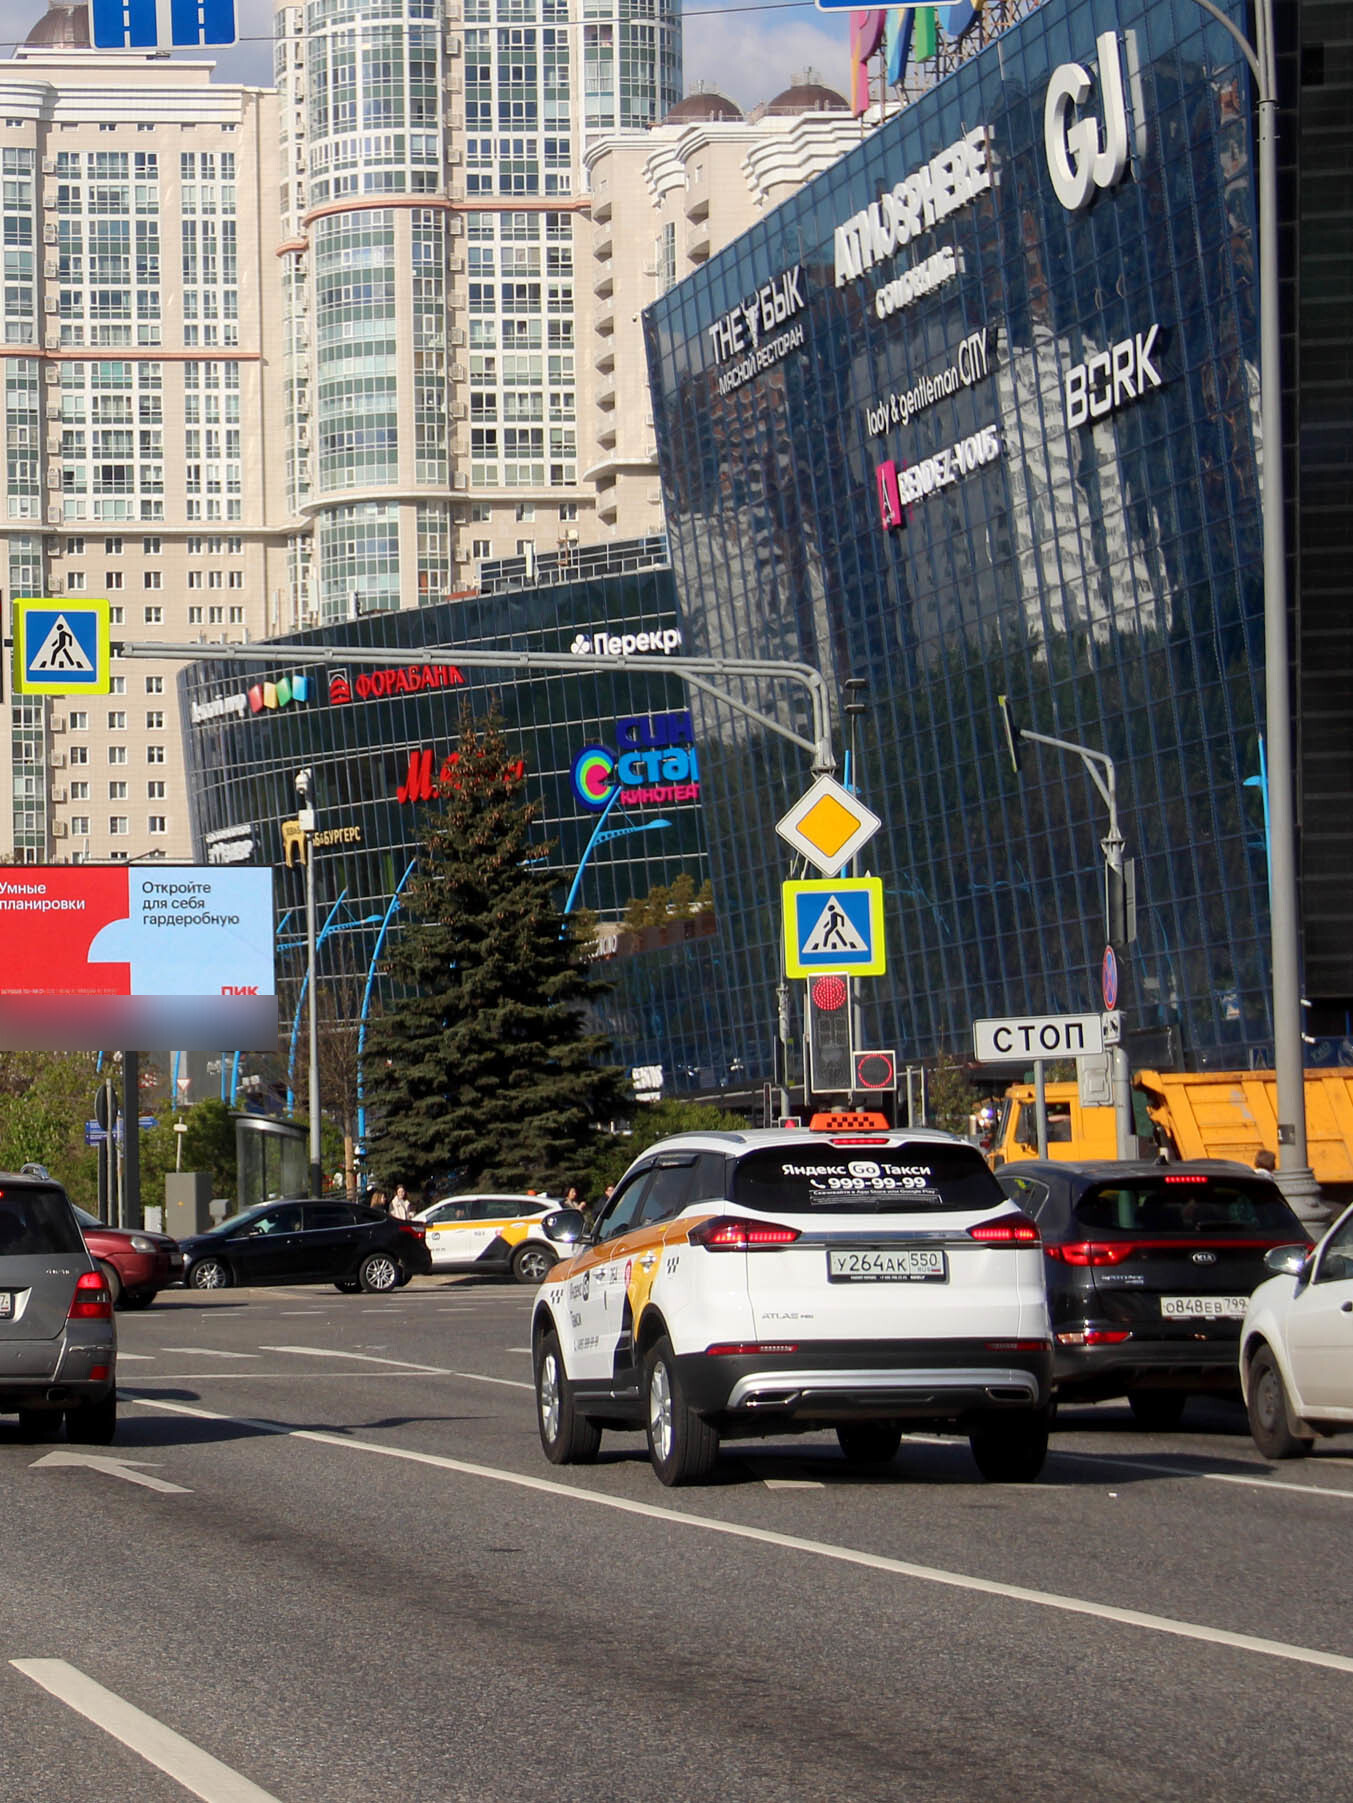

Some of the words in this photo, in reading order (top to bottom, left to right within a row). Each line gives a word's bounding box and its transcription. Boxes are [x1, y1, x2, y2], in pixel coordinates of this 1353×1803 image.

[1044, 30, 1128, 211] GJ
[708, 306, 745, 365] THE
[759, 264, 805, 332] БЫК
[718, 352, 758, 396] МЯСНОЙ
[756, 323, 804, 371] РЕСТОРАН
[866, 408, 889, 436] lady
[890, 394, 900, 424] &
[899, 367, 959, 425] gentleman
[958, 327, 990, 386] CITY
[1066, 323, 1162, 430] BORK
[897, 424, 999, 505] RENDEZ-VOUS
[593, 628, 682, 655] Перекр
[355, 664, 465, 700] ФОРАБАНК
[142, 881, 211, 896] Откройте
[0, 898, 86, 911] планировки
[142, 900, 168, 911] для
[171, 897, 205, 909] себя
[143, 912, 240, 926] гардеробную
[993, 1022, 1084, 1053] СТОП
[782, 1163, 846, 1176] Яндекс
[852, 1163, 877, 1175] Go
[881, 1163, 931, 1175] Такси
[827, 1177, 926, 1189] 999-99-99
[837, 1254, 906, 1272] У264АК
[910, 1253, 938, 1266] 550
